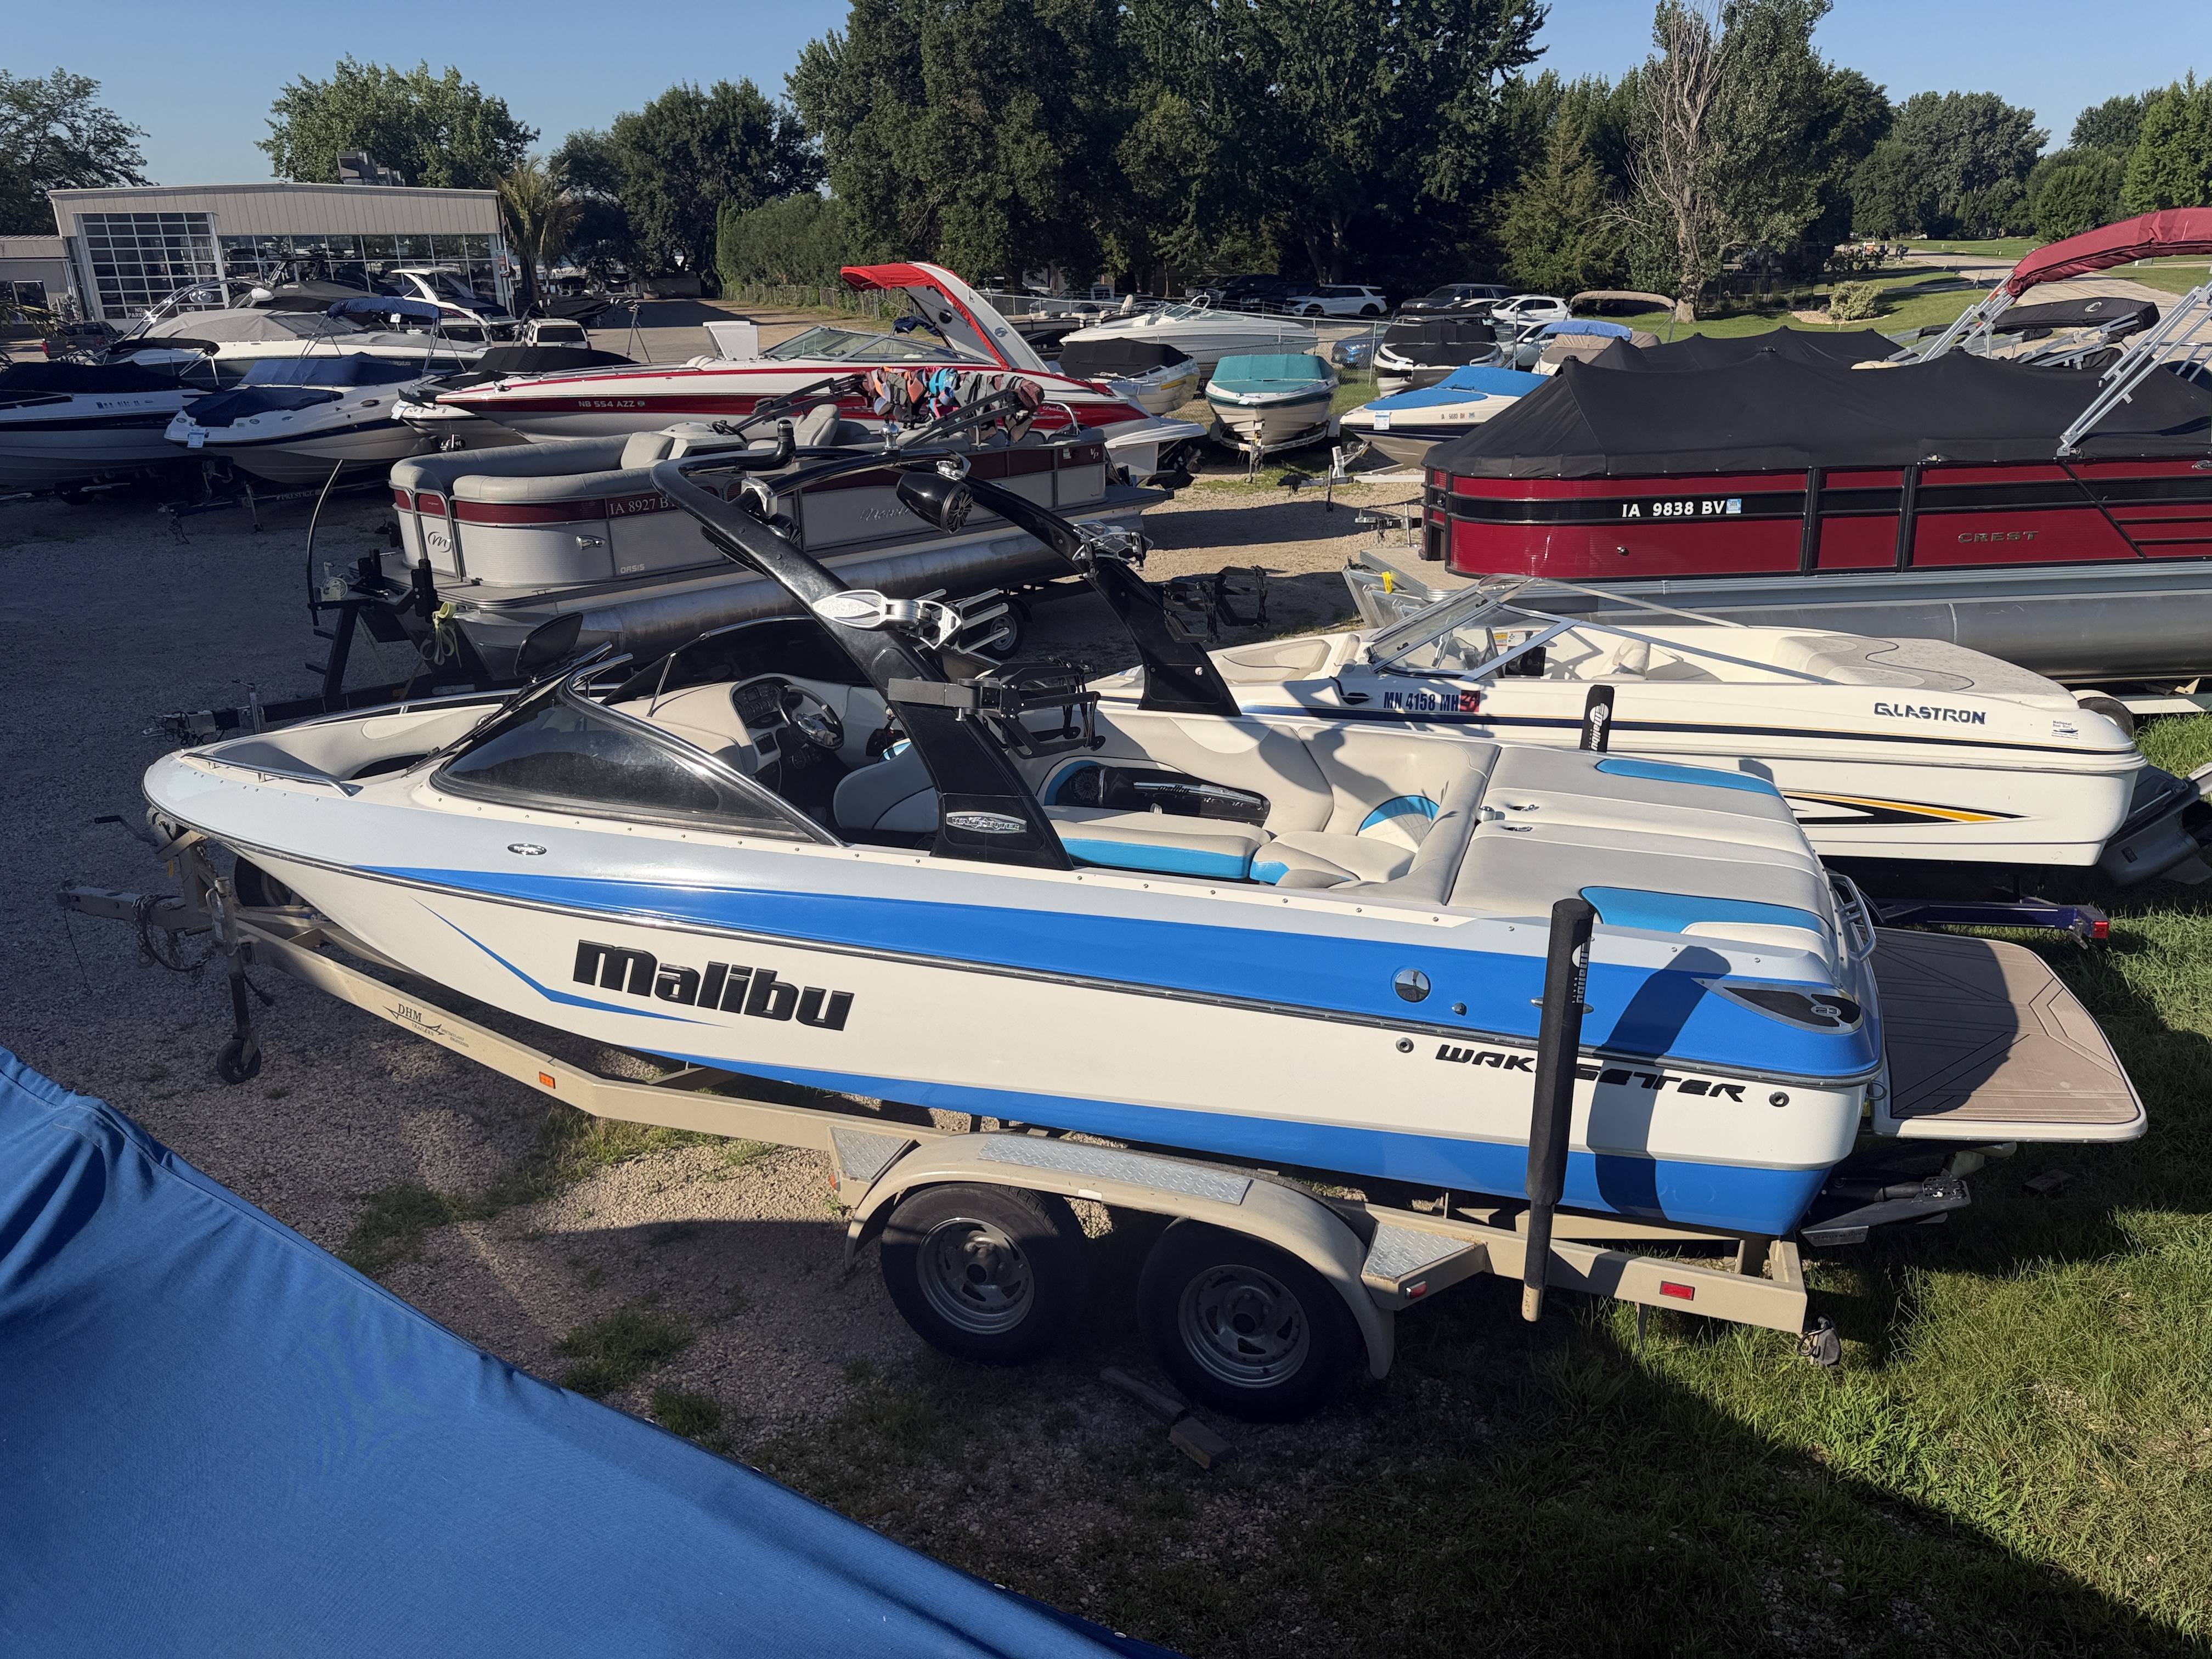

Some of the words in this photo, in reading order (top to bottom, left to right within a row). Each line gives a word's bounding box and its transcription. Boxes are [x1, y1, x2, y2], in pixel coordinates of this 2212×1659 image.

[610, 503, 625, 515] IA
[628, 498, 656, 512] 8927
[659, 496, 676, 509] B
[1622, 504, 1641, 517] IA
[1652, 501, 1694, 516] 9838
[1701, 500, 1725, 515] BV
[1958, 531, 2039, 543] CREST
[620, 563, 645, 574] OASIS
[1383, 692, 1403, 708] MN
[1406, 693, 1436, 711] 4158
[1440, 694, 1459, 712] MH
[1874, 702, 1986, 725] GLASTRON
[398, 1003, 422, 1023] DHM
[411, 1022, 434, 1036] TRAILERS
[1435, 1045, 1746, 1103] WAKSETTER
